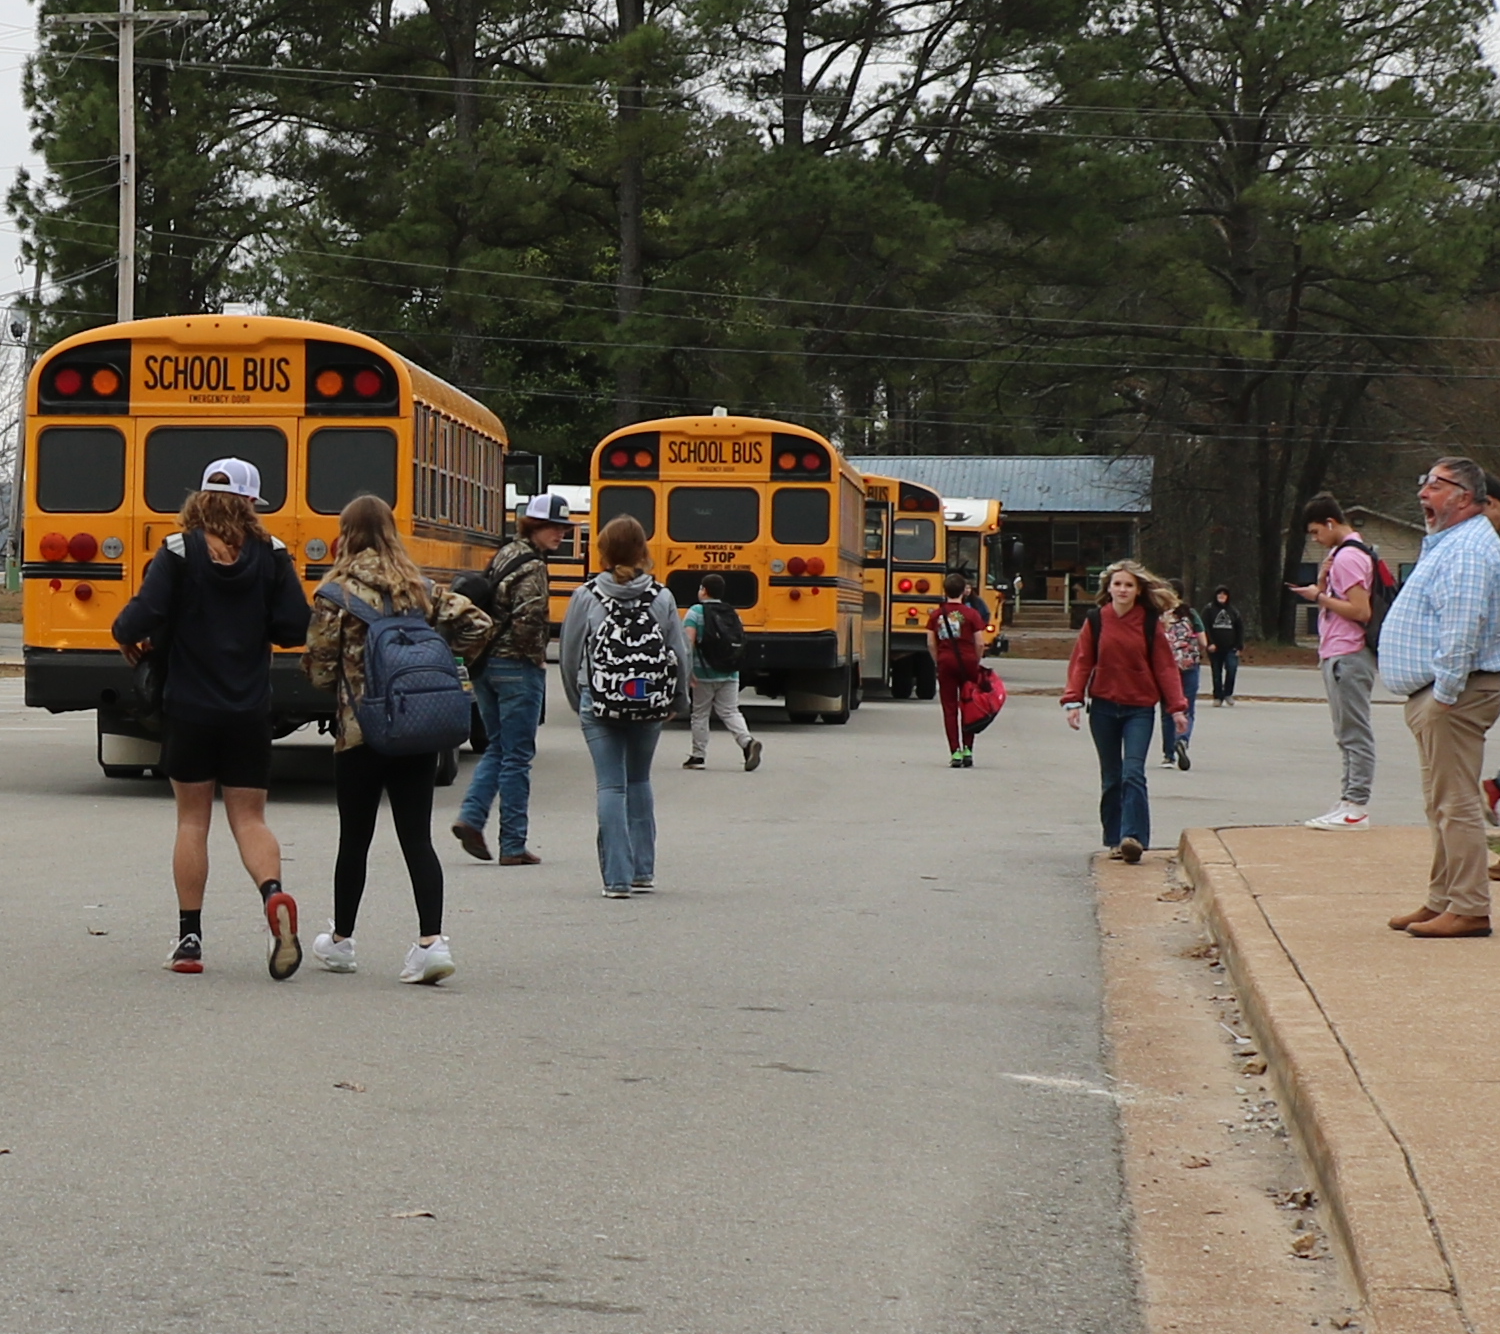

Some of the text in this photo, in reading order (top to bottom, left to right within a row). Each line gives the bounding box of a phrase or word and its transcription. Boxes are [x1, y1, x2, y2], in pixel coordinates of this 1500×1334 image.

[144, 355, 291, 393] SCHOOL BUS
[188, 394, 251, 404] EMERGENCY DOOR
[668, 441, 764, 464] SCHOOL BUS
[703, 551, 736, 563] STOP
